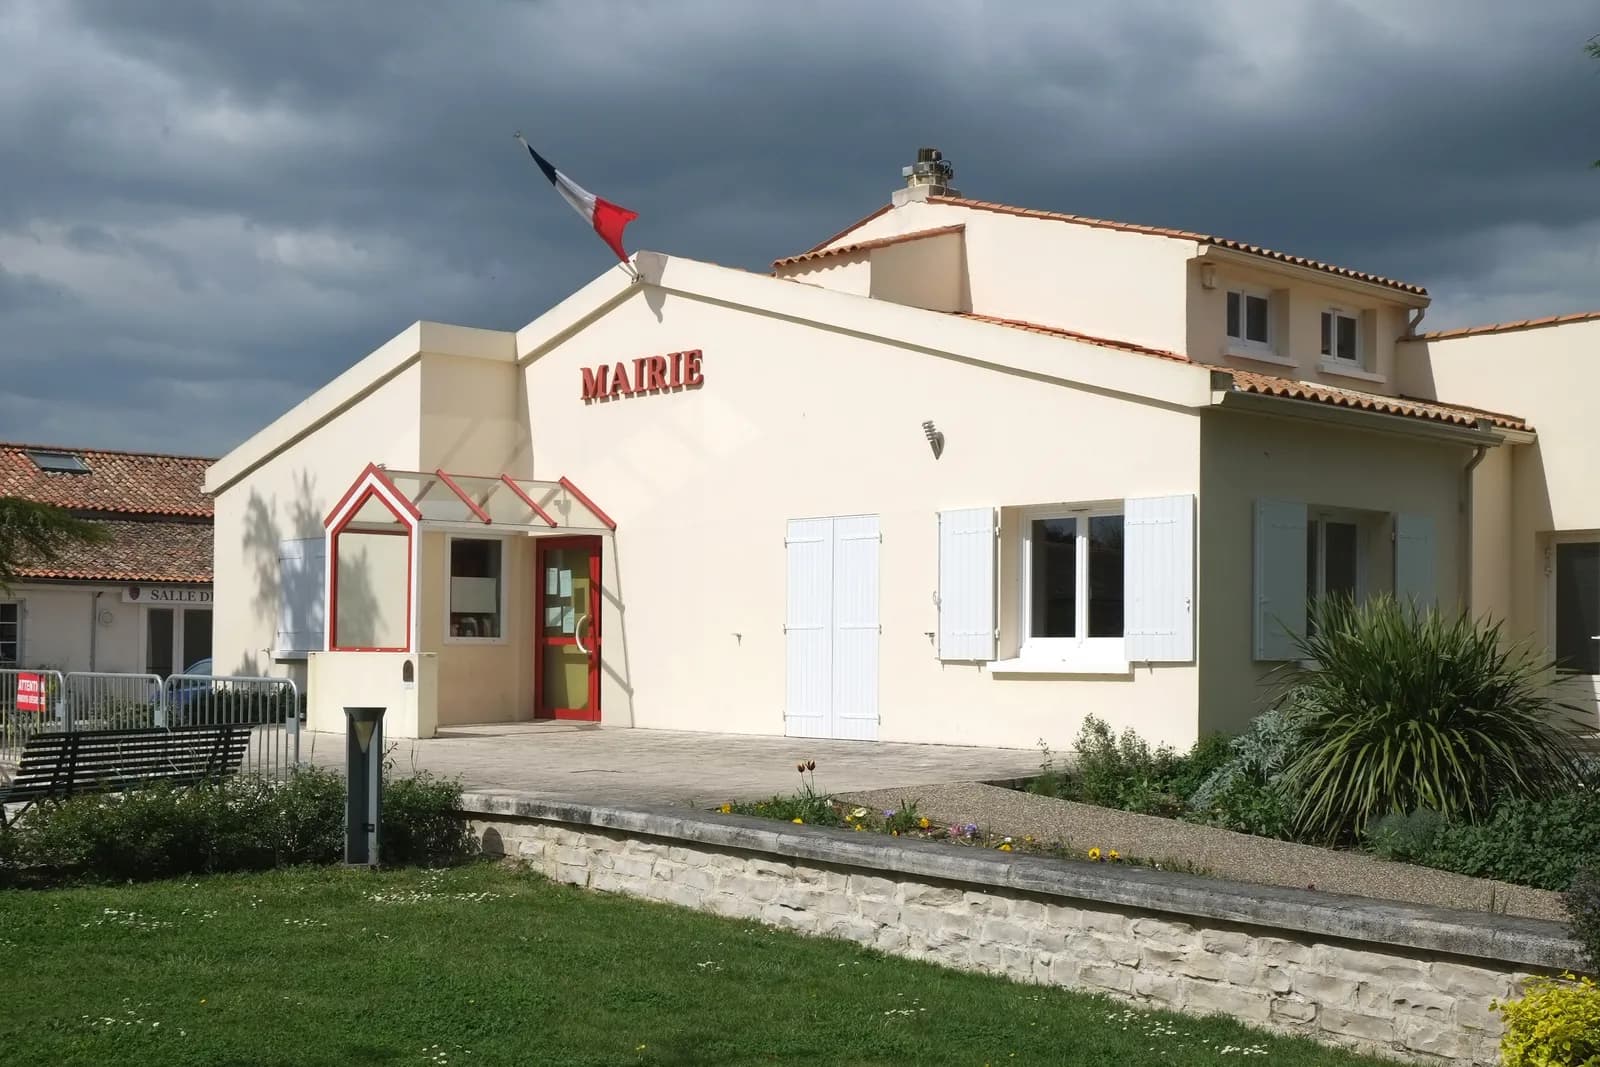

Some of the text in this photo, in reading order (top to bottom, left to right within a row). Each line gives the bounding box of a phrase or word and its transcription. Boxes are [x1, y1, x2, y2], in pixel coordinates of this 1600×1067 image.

[580, 349, 704, 402] MAIRIE
[150, 589, 196, 601] SALLE
[18, 679, 46, 691] ATTENTIN
